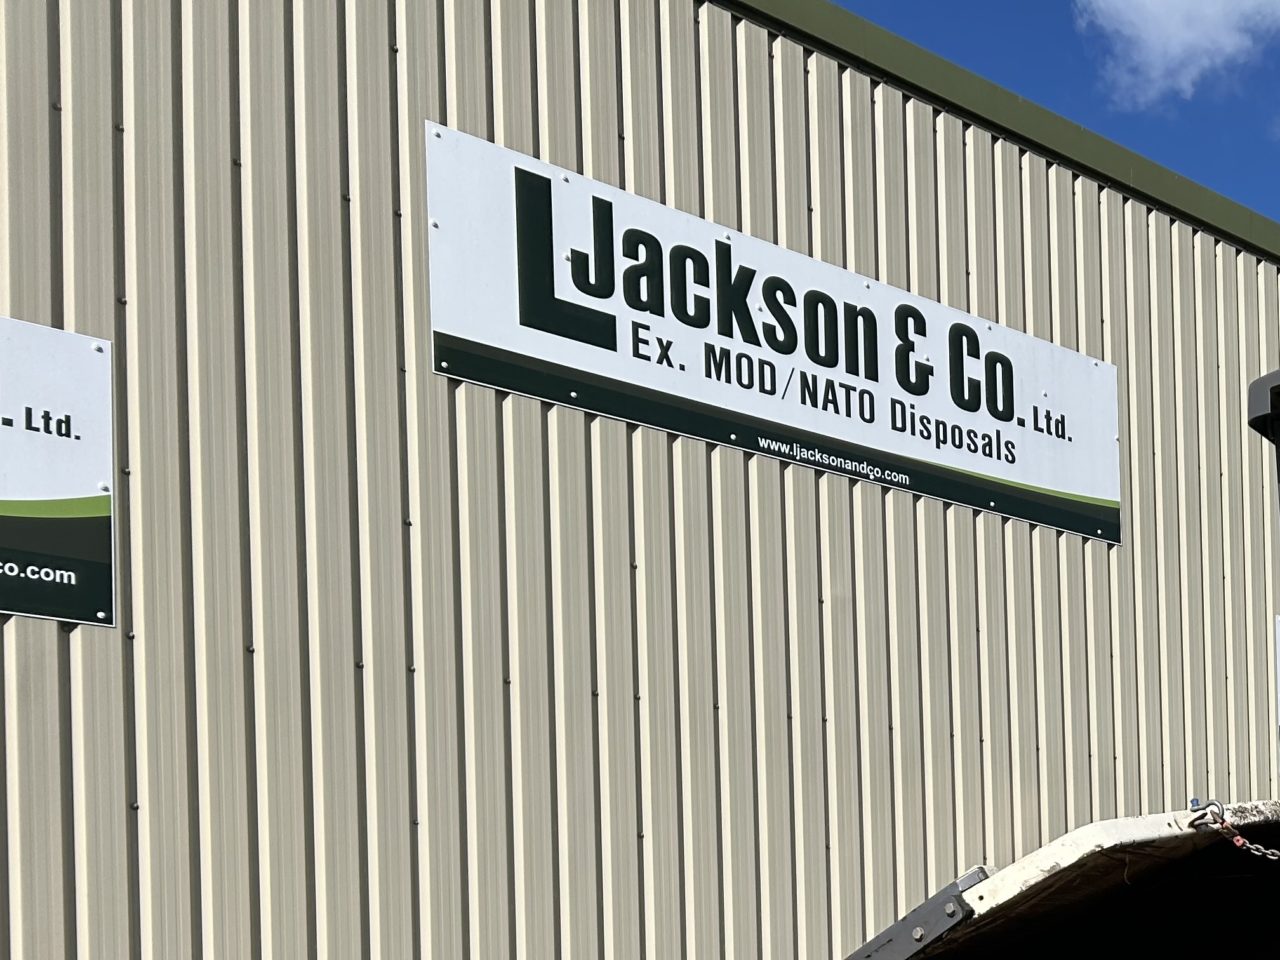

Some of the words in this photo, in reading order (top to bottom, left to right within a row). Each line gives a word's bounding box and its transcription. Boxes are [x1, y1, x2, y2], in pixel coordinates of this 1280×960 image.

[631, 320, 687, 372] Ex.
[703, 341, 877, 425] MOD/NATO
[890, 397, 1017, 465] Disposals
[894, 303, 935, 396] &
[948, 322, 1027, 428] Co.
[1032, 404, 1074, 442] Ltd.
[24, 406, 81, 441] Ltd.
[757, 436, 910, 485] www.ljacksonandco.com
